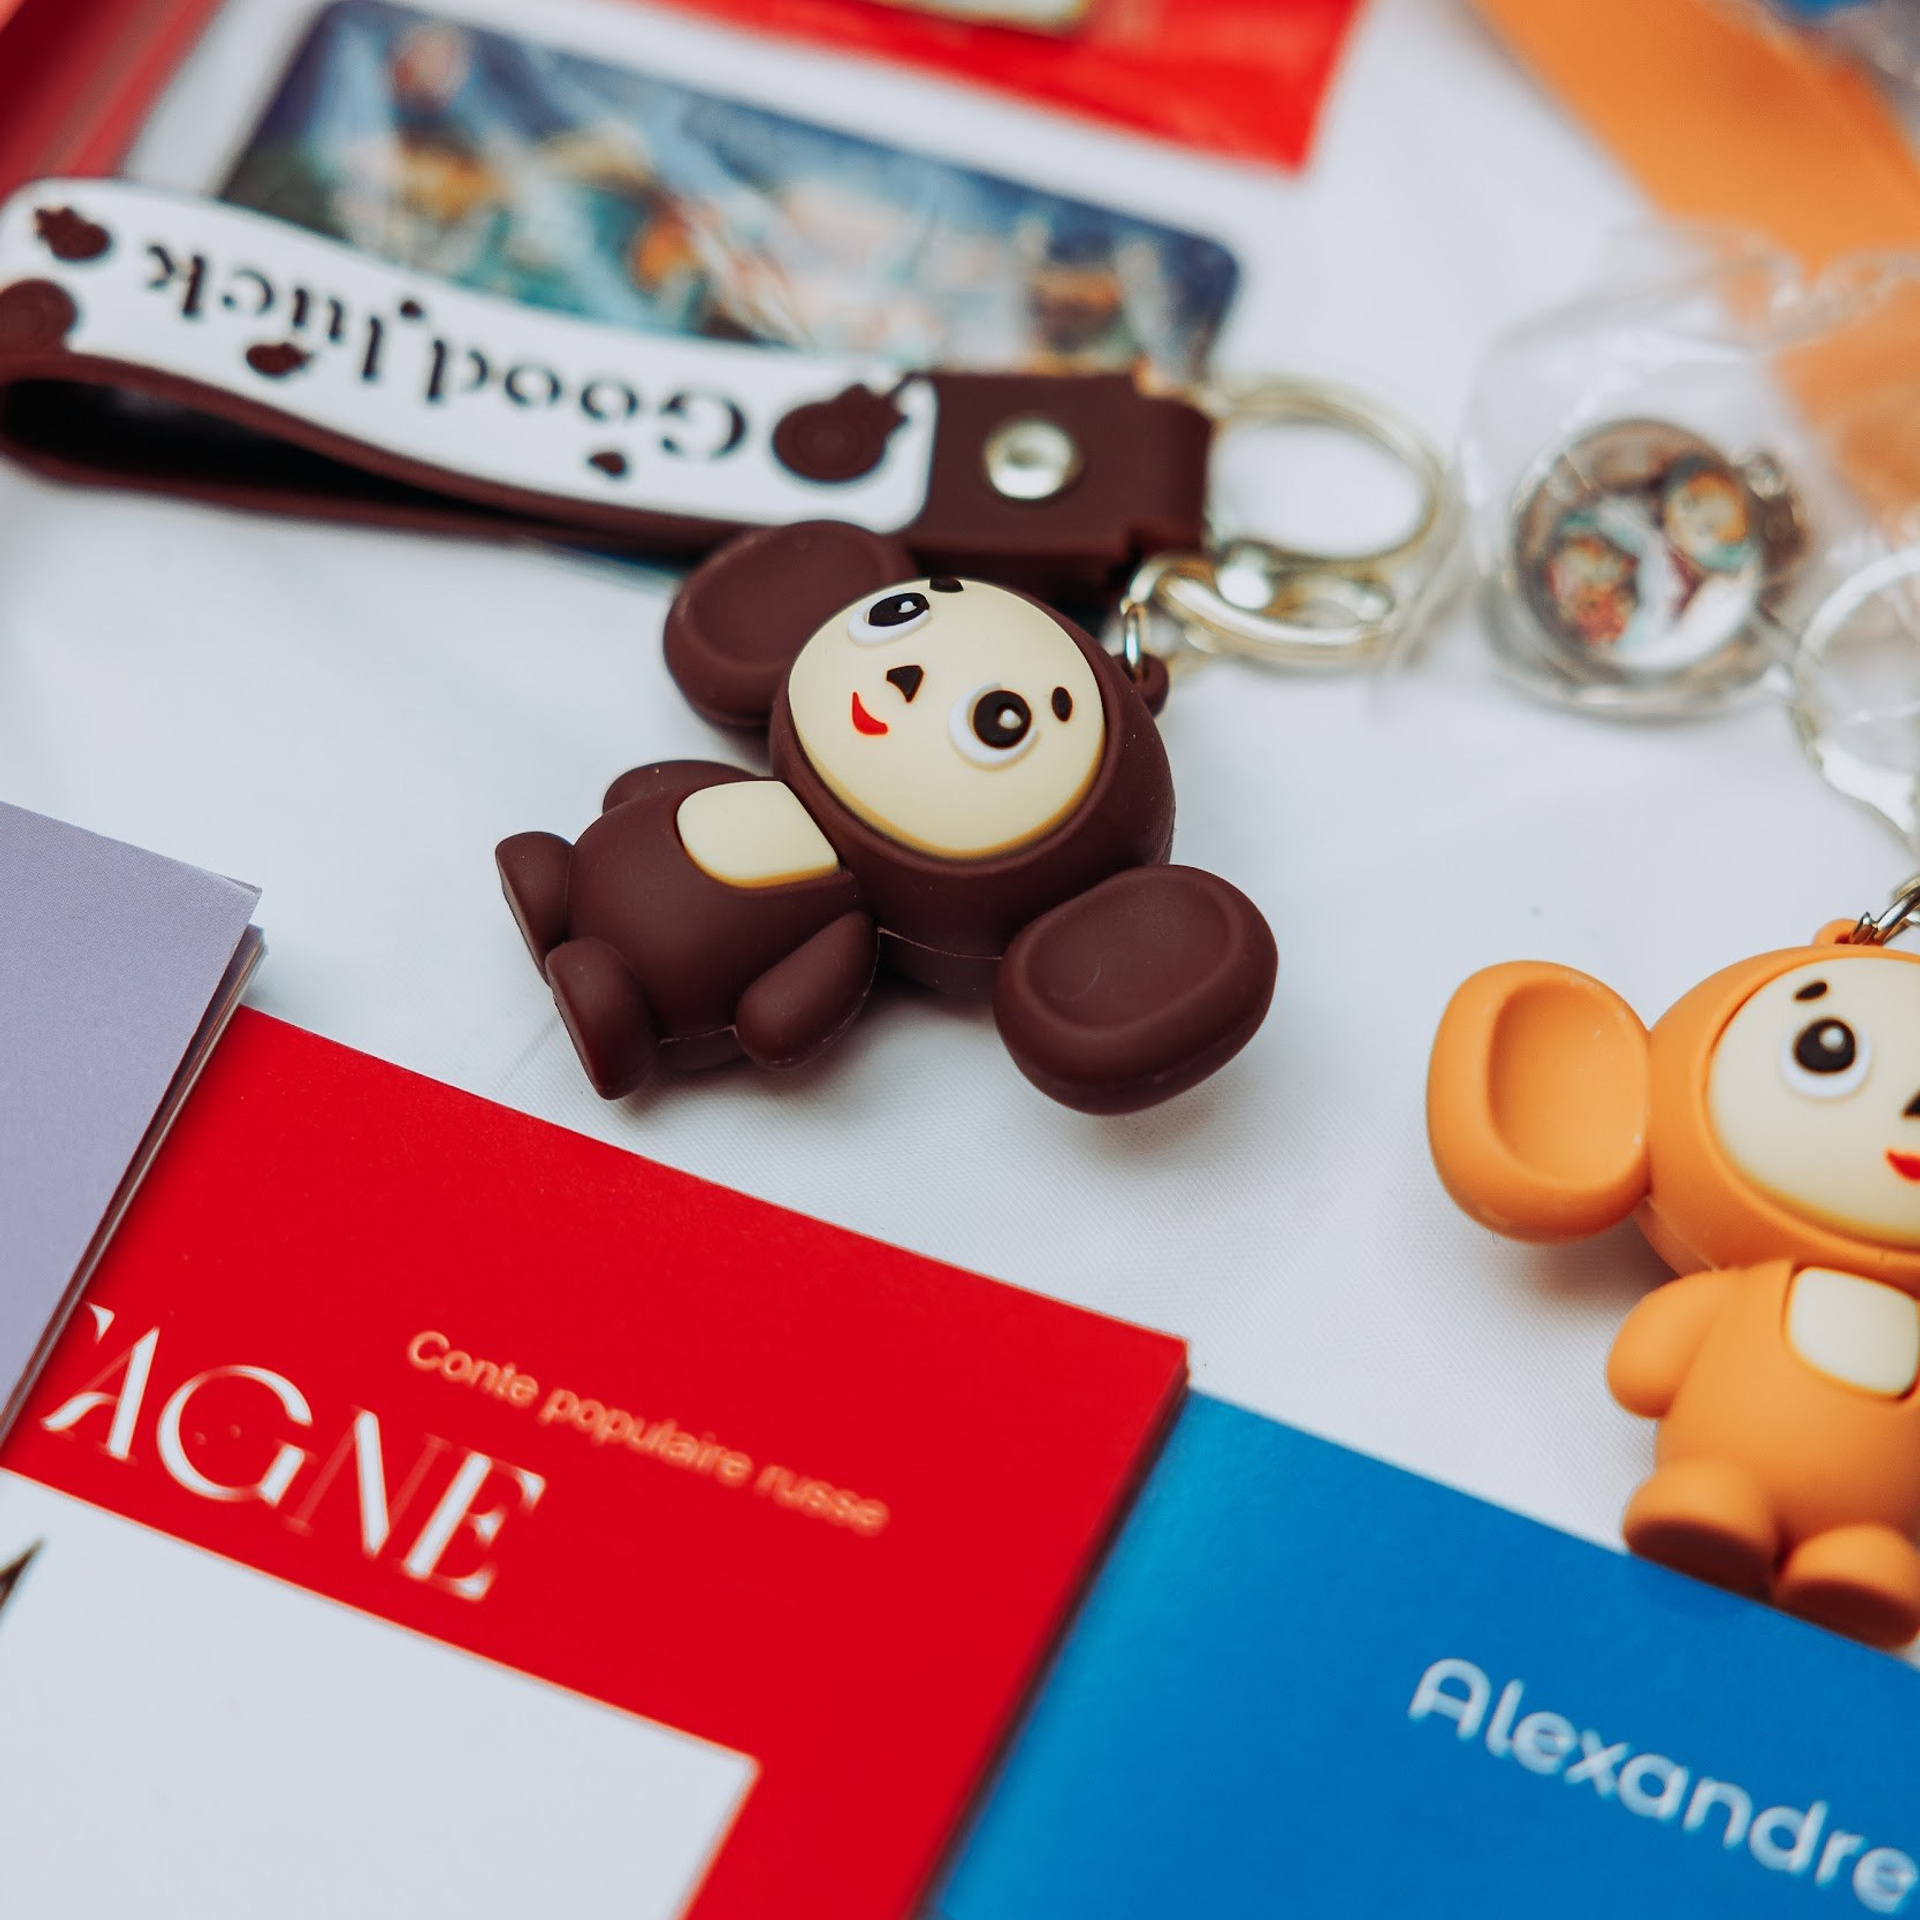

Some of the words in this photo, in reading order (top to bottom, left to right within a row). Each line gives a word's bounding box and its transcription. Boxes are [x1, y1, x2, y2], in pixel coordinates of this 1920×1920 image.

[144, 243, 383, 382] luck
[425, 338, 748, 460] Good
[407, 1331, 538, 1407] Conte
[538, 1388, 752, 1488] populaire
[754, 1463, 890, 1536] russe
[1407, 1657, 1919, 1914] Alexandre
